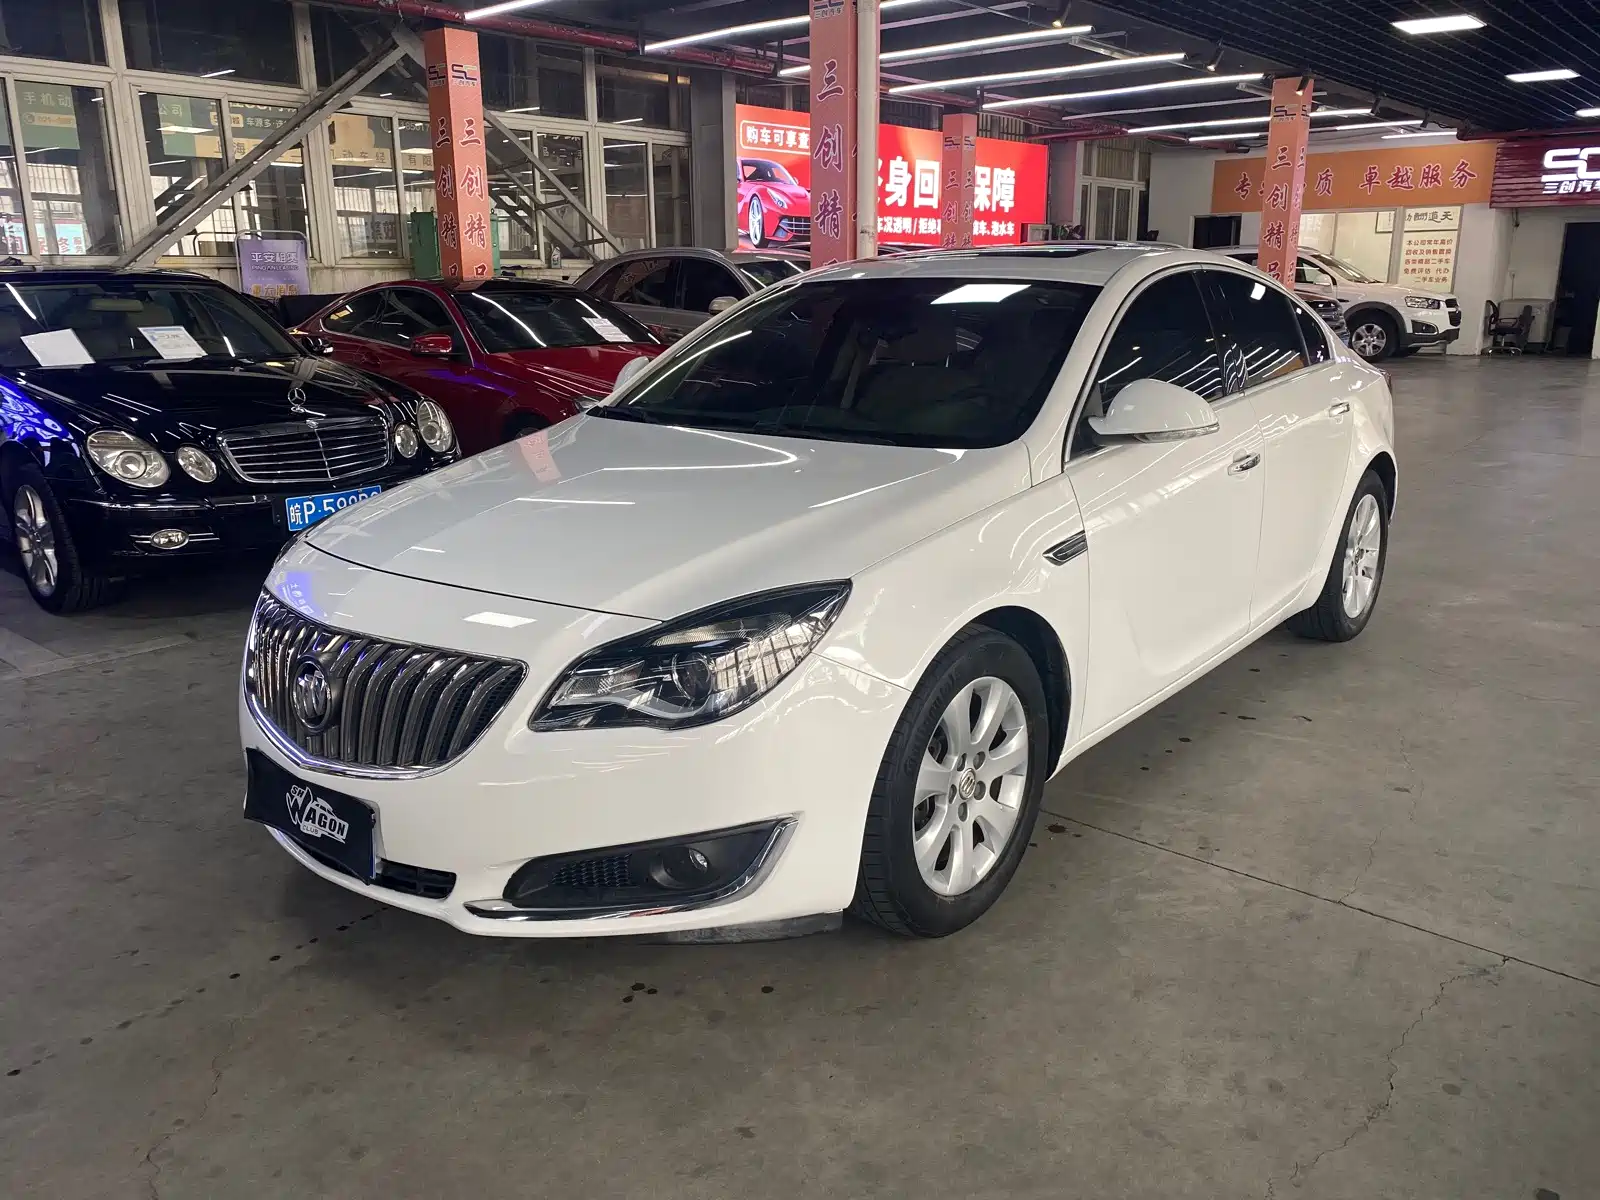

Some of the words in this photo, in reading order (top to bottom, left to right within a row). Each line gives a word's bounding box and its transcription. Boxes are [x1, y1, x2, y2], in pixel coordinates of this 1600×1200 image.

[814, 59, 845, 266] 三创精
[1358, 159, 1477, 196] 卓越服务
[286, 787, 349, 840] WAGON
